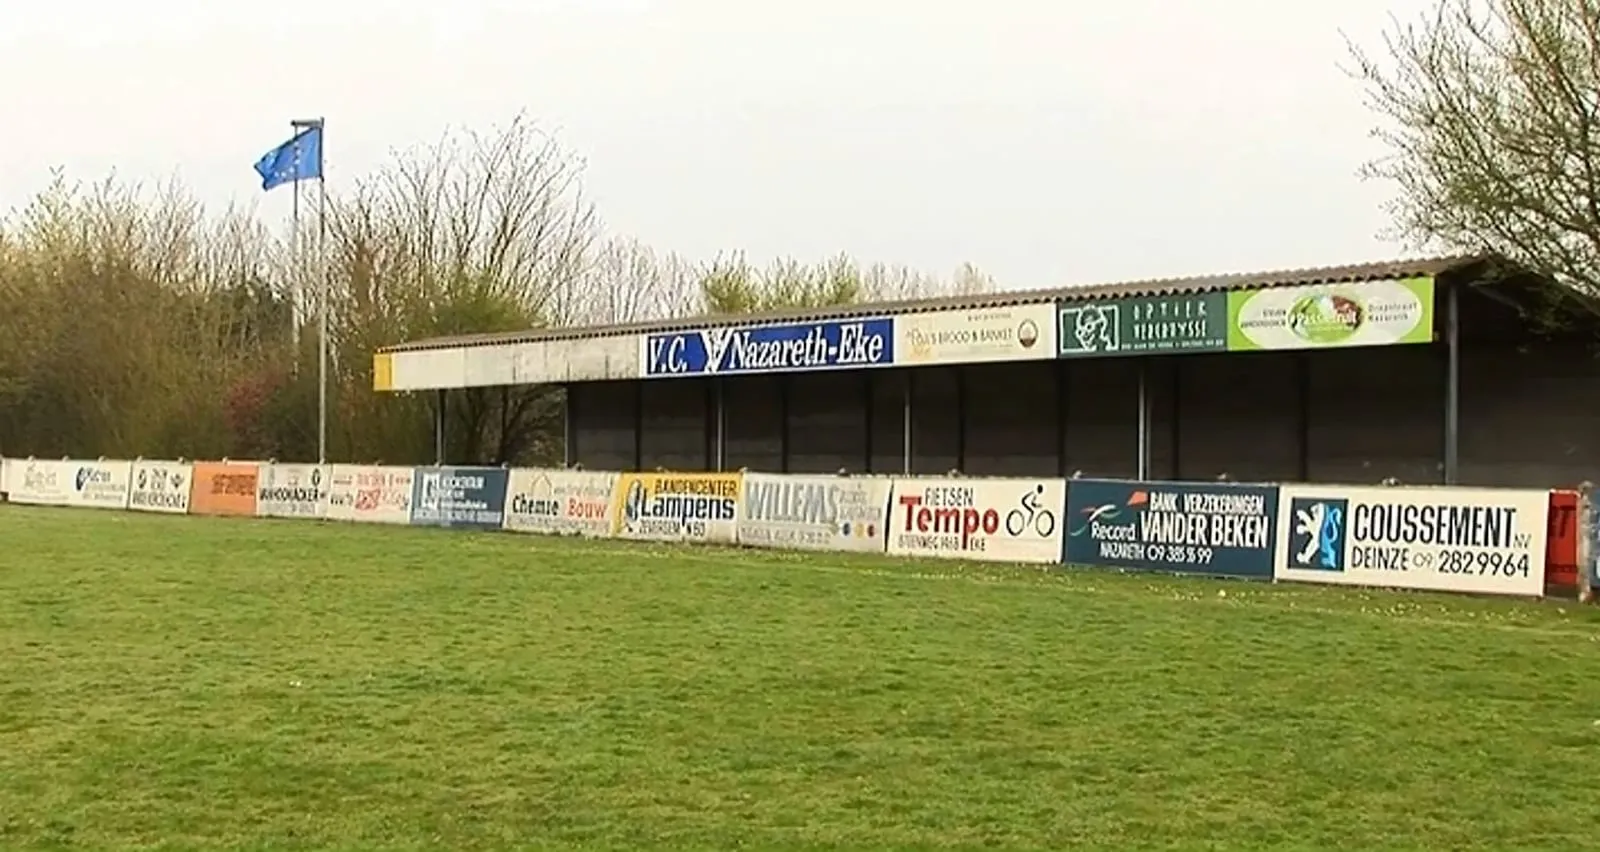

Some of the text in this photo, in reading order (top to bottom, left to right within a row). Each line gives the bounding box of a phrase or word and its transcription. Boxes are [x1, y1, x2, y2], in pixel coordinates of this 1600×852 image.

[649, 323, 884, 373] V.C. Nazareth-Eke
[655, 479, 737, 496] BANDENCENTER
[925, 487, 974, 507] FIETSEN
[512, 493, 559, 516] Chemie
[569, 497, 607, 519] Bouw
[641, 487, 735, 527] Lampens
[746, 481, 838, 525] WILLEMS
[1150, 492, 1265, 516] BANK VERZEKERINGEN
[899, 495, 999, 550] Tempo
[1091, 521, 1136, 541] Record
[1141, 510, 1269, 549] VANDER BEKEN
[1354, 504, 1517, 548] COUSSEMENT
[1147, 544, 1165, 562] 09
[1197, 547, 1213, 564] 99
[1352, 546, 1410, 571] DEINZE
